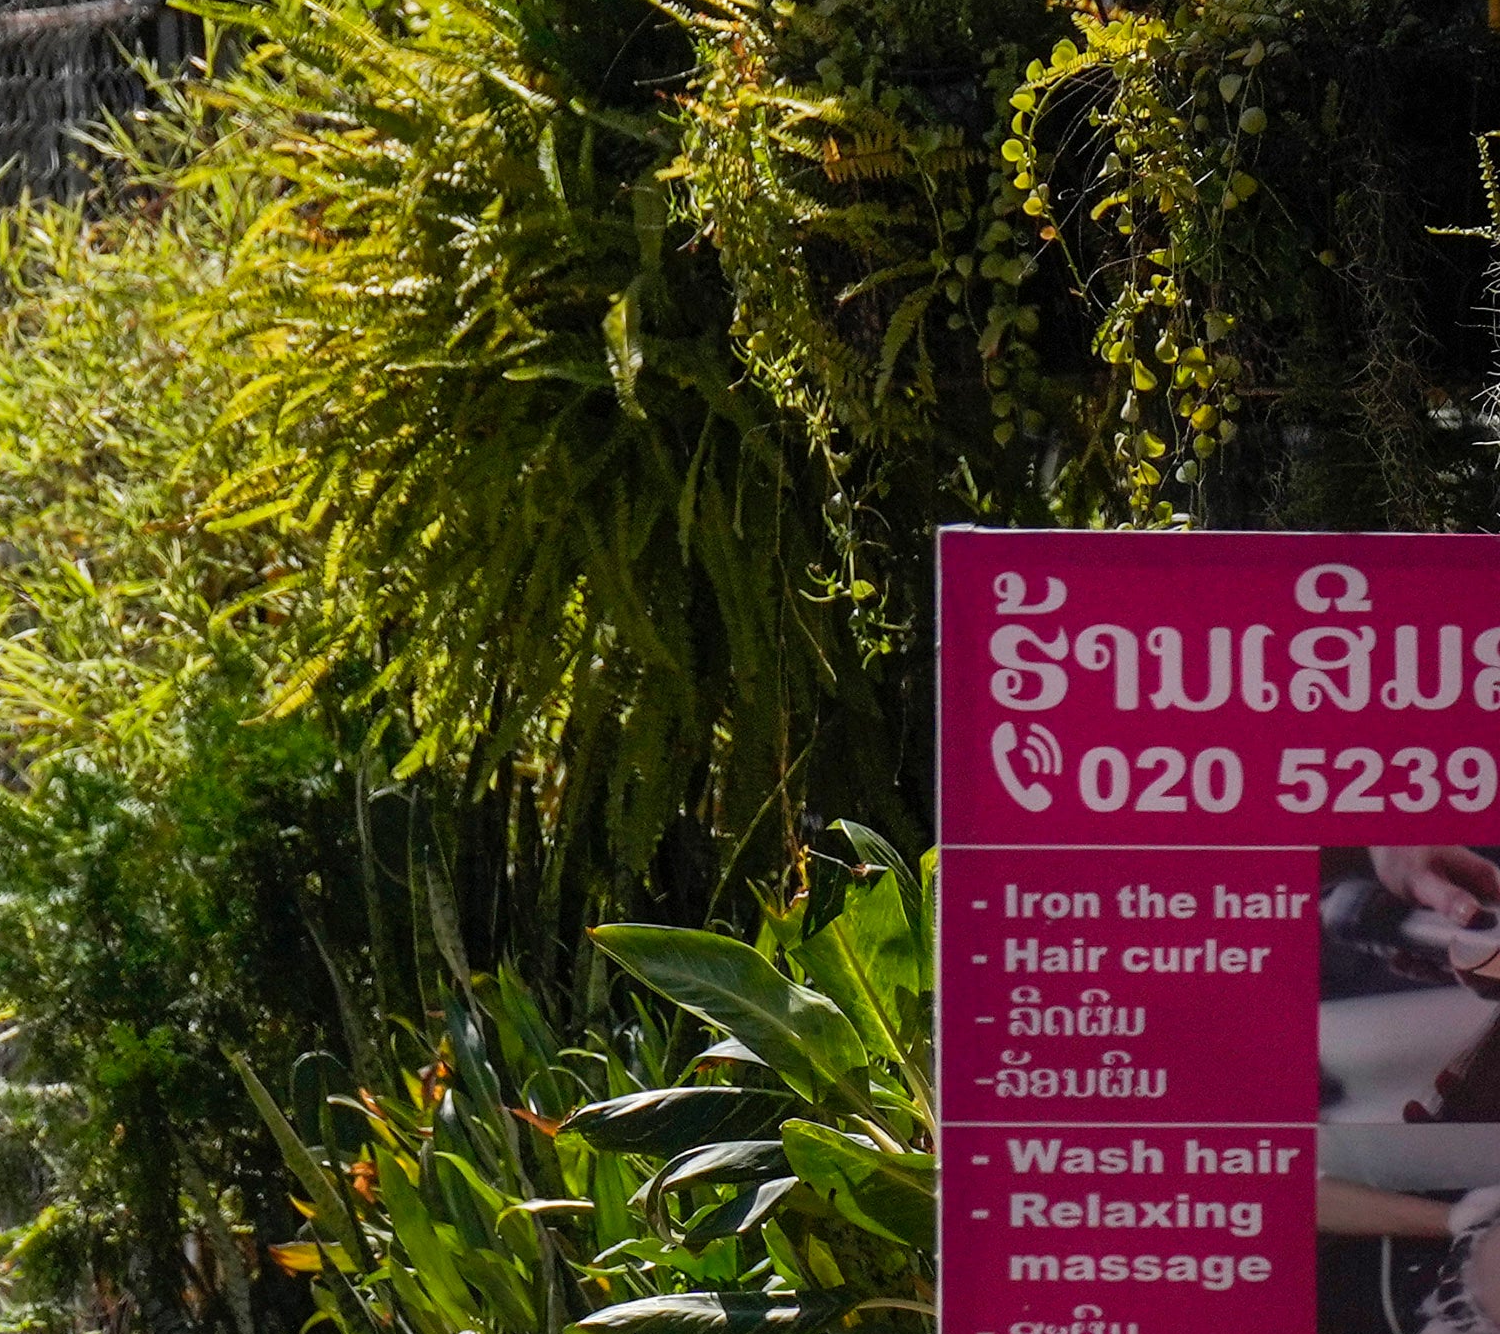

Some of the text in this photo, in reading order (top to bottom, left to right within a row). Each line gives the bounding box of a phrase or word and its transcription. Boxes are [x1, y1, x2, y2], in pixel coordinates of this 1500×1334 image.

[1078, 746, 1498, 814] 020 5239
[1005, 883, 1310, 920] Iron the hair
[1004, 937, 1271, 974] Hair curler
[1007, 1138, 1300, 1174] Wash hair
[1010, 1191, 1263, 1238] Relaxing
[1009, 1254, 1272, 1291] massage
